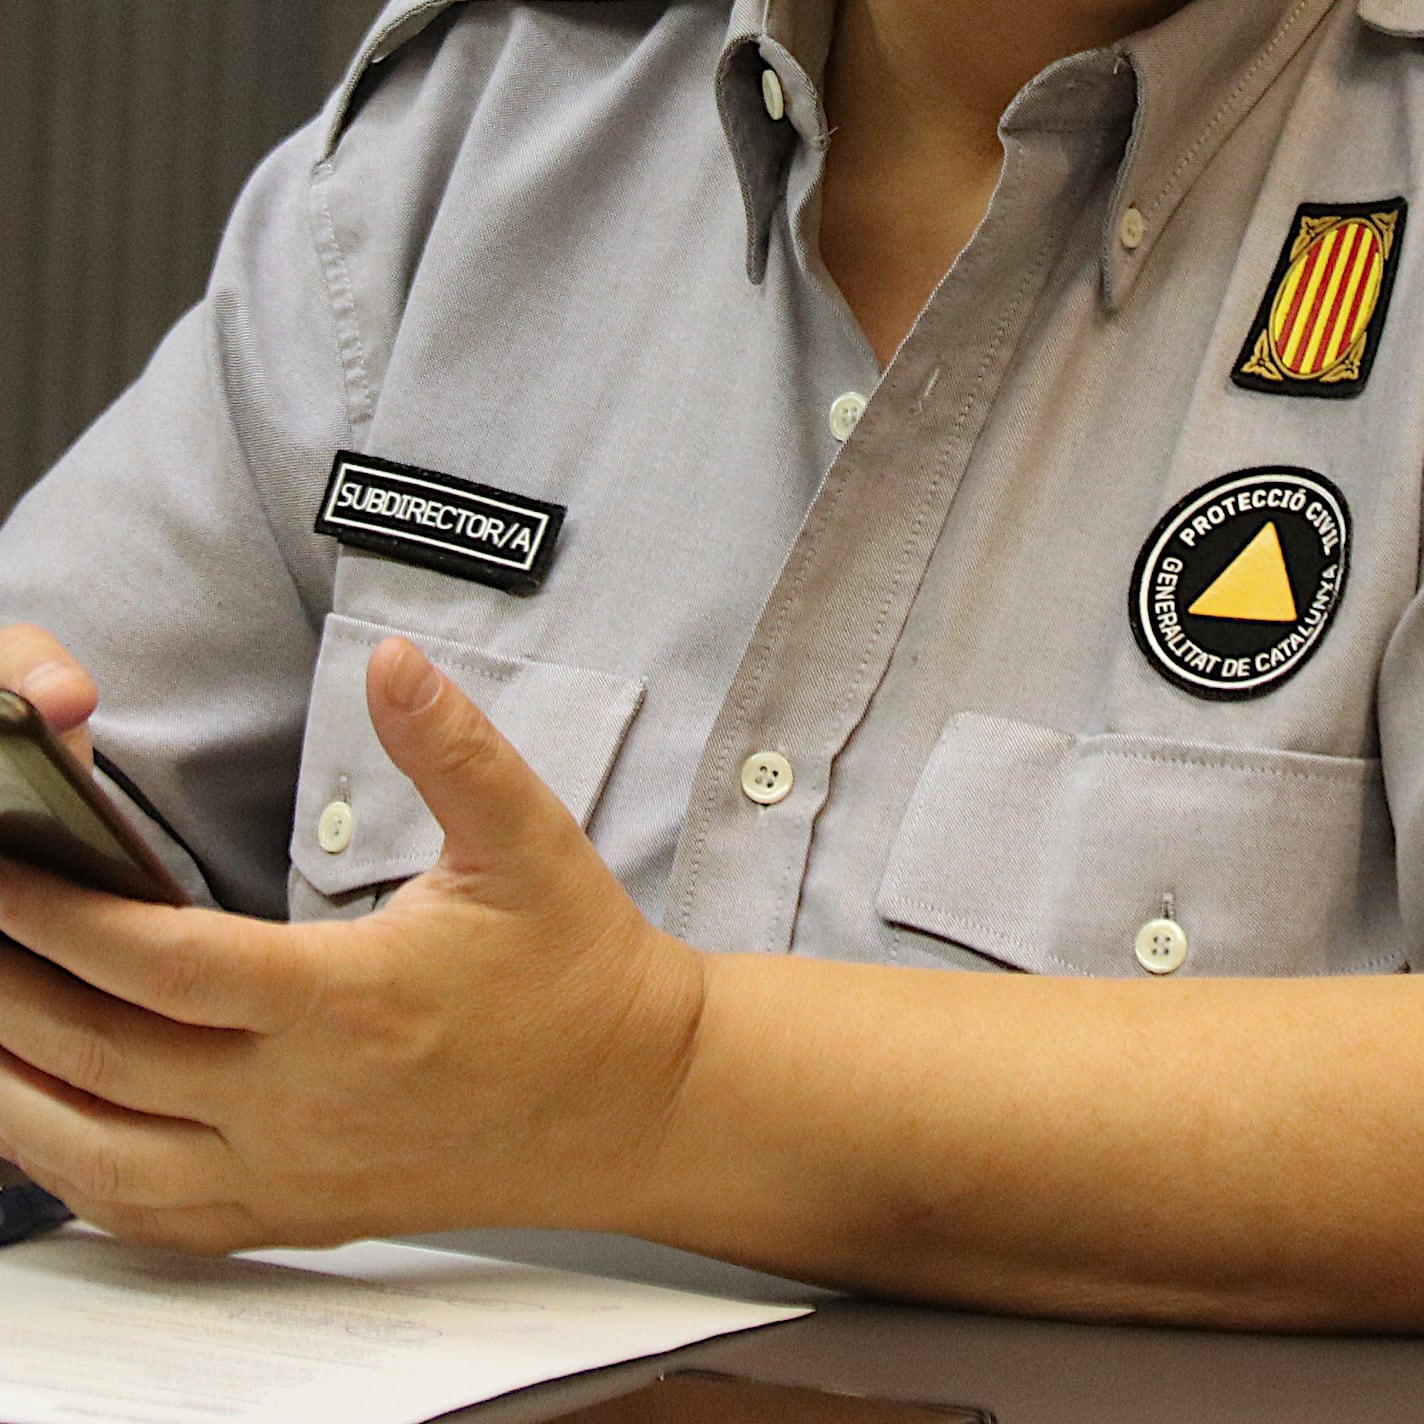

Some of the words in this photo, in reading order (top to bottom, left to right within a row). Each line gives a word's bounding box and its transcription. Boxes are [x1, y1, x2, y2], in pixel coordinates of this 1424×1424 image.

[337, 482, 532, 553] SUBDIRECTOR/A
[1179, 488, 1306, 547] PROTECCIÓ
[1304, 501, 1340, 556] CIVIL
[1154, 556, 1222, 673] GENERALITAT
[1221, 657, 1253, 677] DE
[1254, 563, 1339, 672] CATALUNYA
